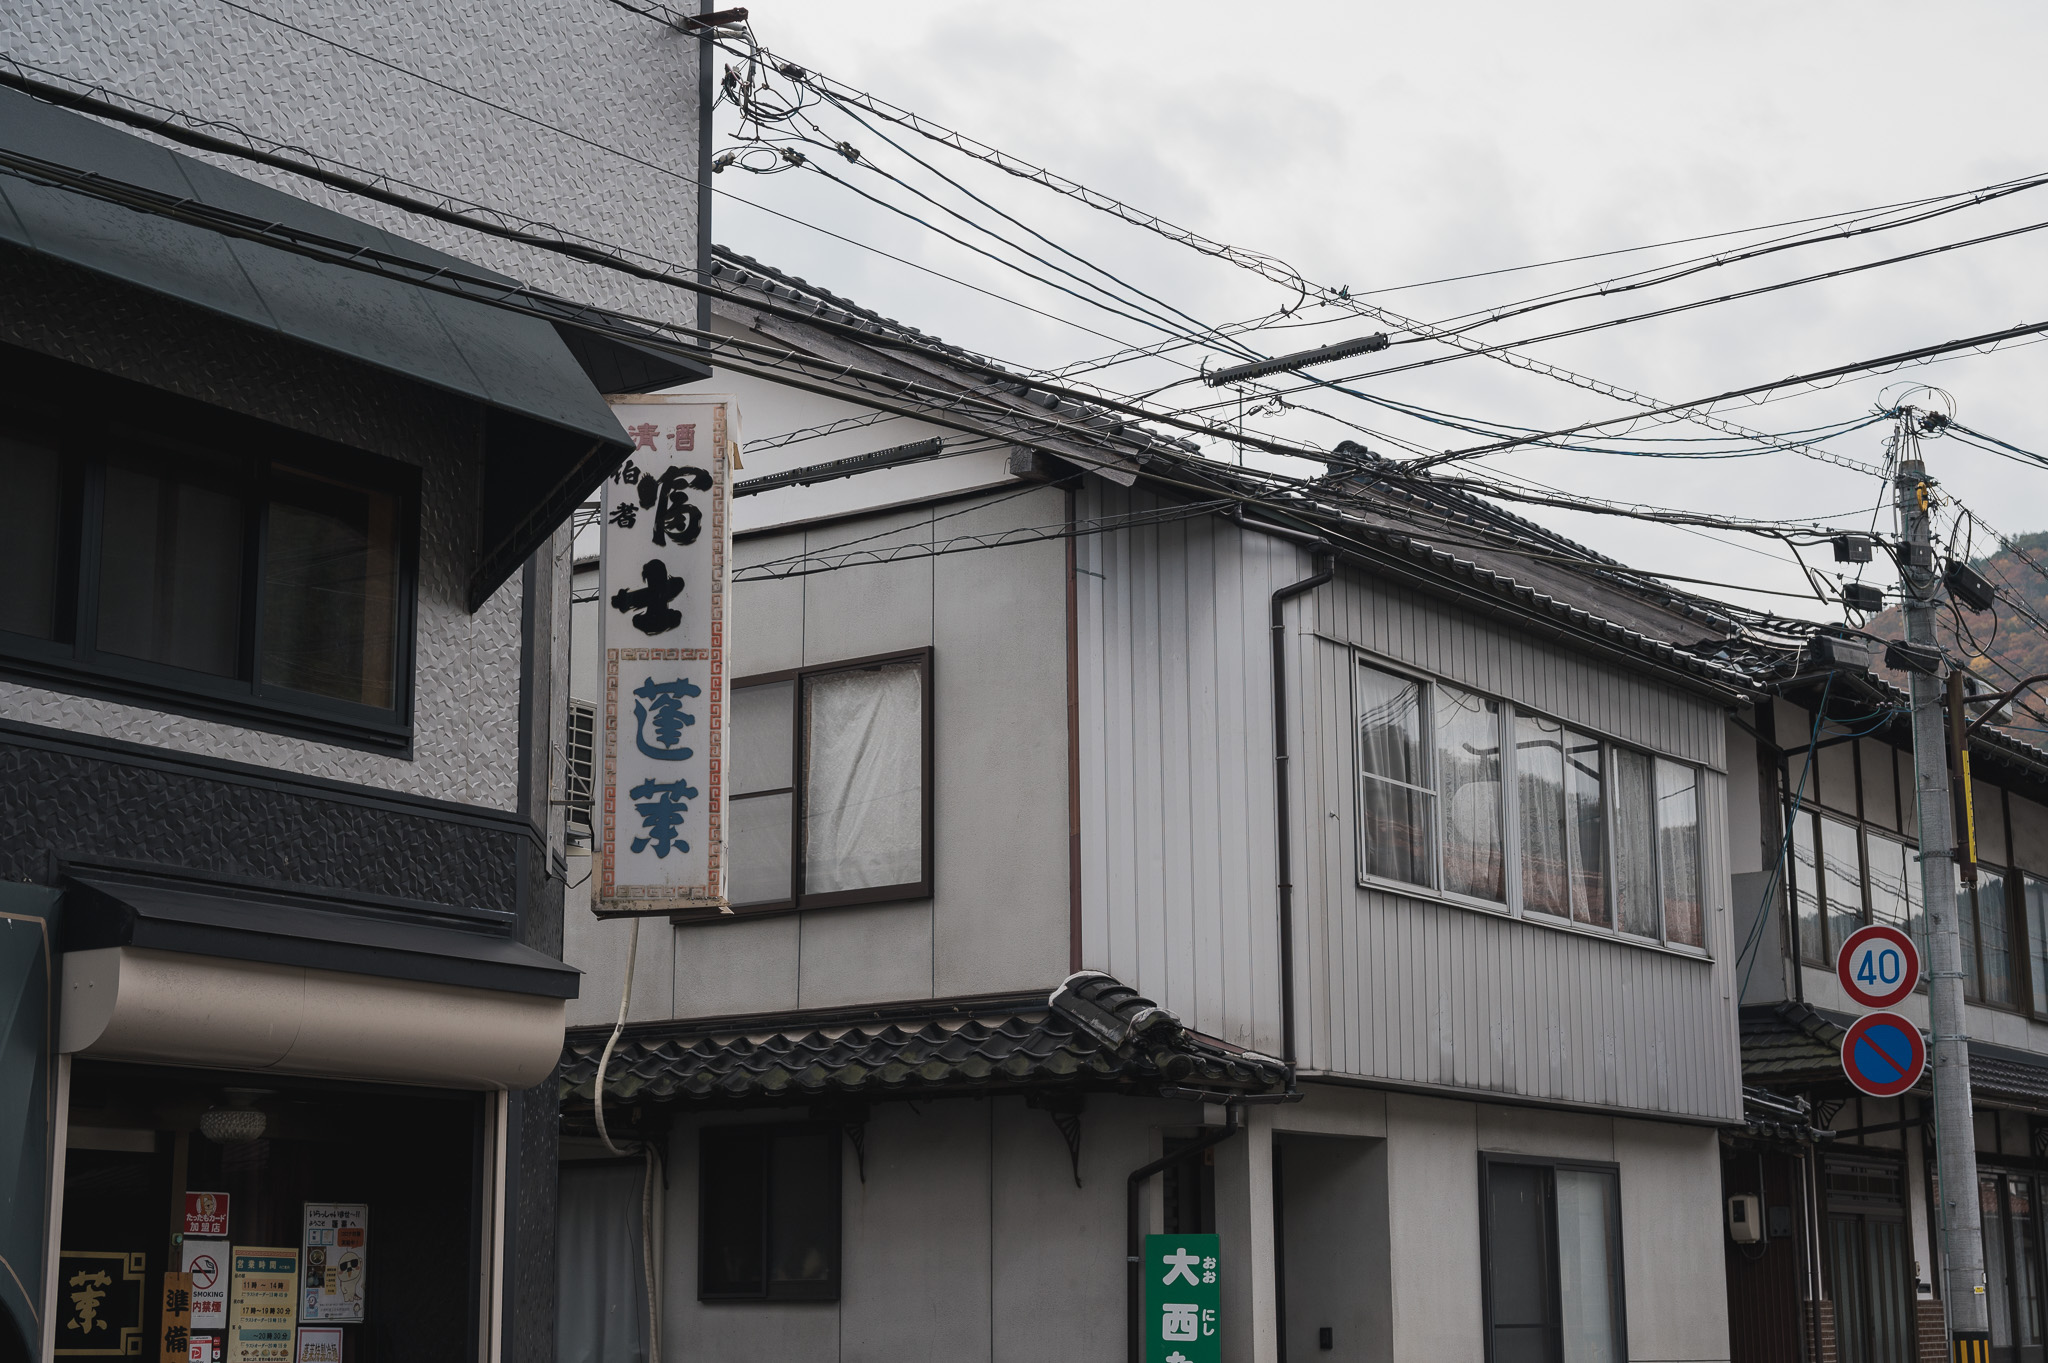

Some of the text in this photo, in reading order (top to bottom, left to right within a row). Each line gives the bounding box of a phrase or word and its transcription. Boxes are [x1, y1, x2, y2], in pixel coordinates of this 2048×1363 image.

[628, 422, 697, 452] 清酒
[1857, 949, 1900, 985] 40
[186, 1213, 226, 1222] たったもカード
[189, 1222, 221, 1233] 加盟店
[237, 1259, 277, 1269] 営業時間
[192, 1300, 222, 1313] 内禁煙
[165, 1289, 189, 1363] 準備
